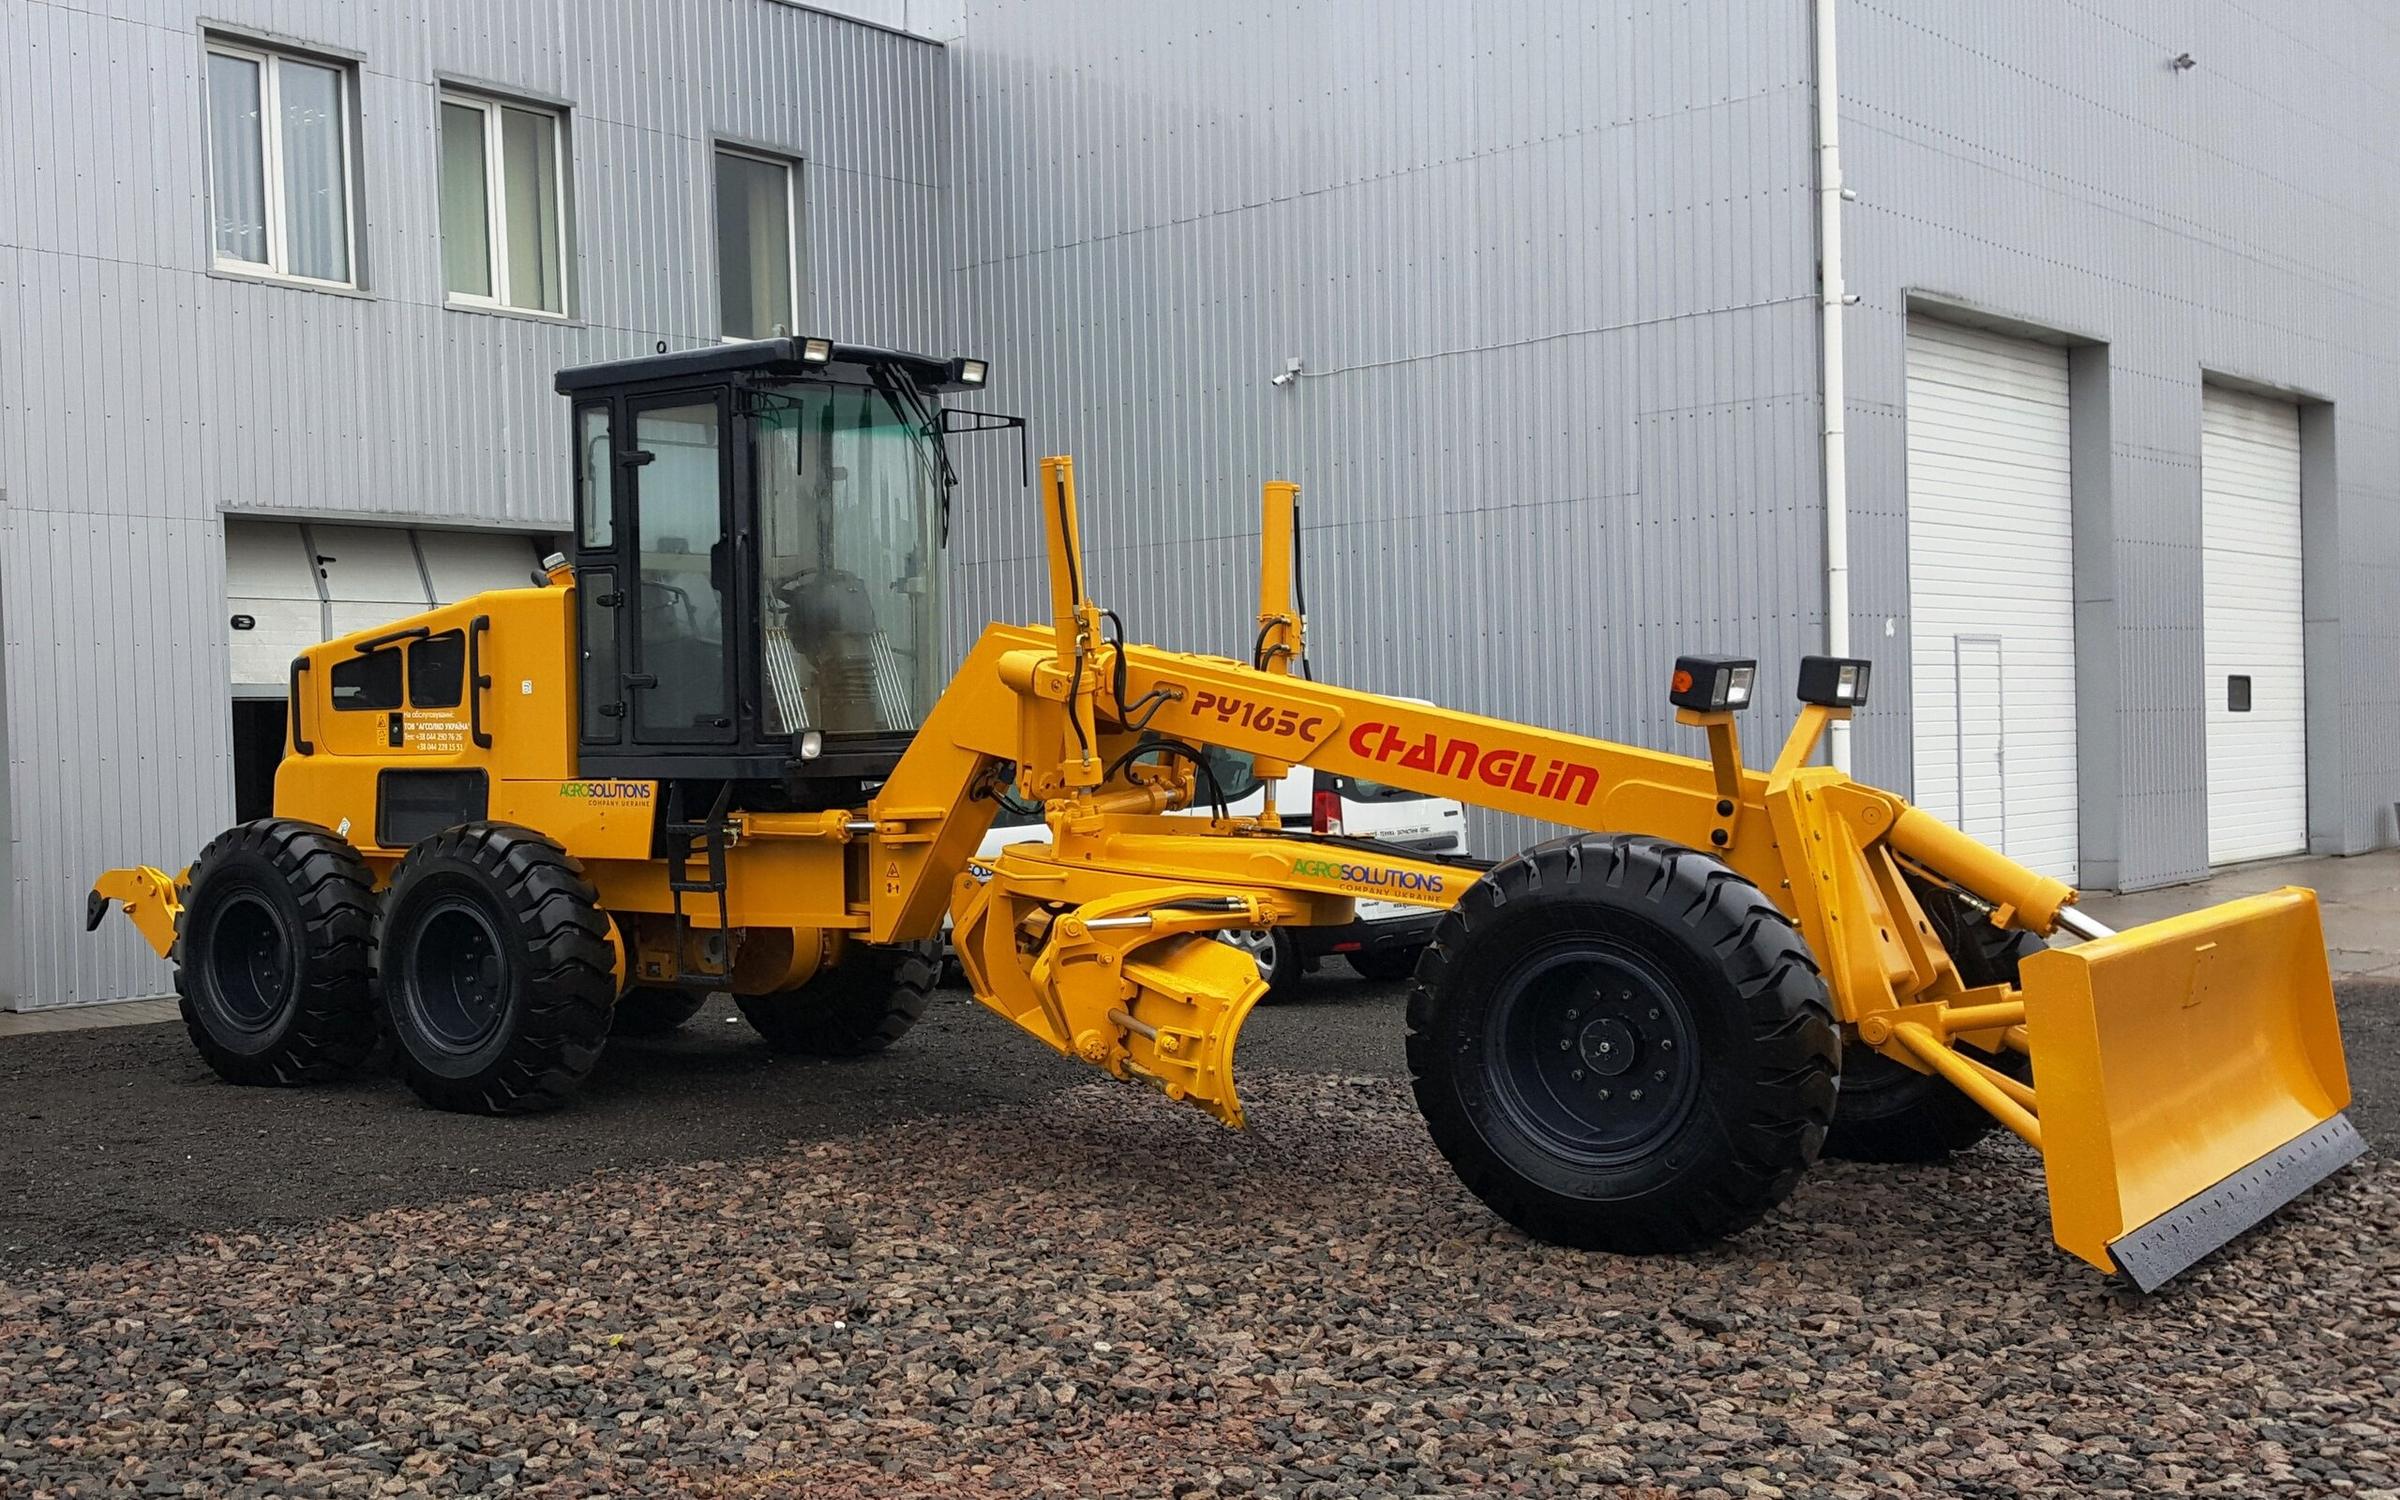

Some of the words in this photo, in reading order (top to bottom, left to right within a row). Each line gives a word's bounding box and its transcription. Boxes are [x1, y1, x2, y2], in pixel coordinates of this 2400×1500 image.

[1190, 691, 1323, 743] PY165C
[1348, 721, 1600, 806] CHANGLIN
[559, 783, 650, 798] AGROSOLUTIONS
[1292, 858, 1444, 893] AGROSOLUTIONS
[1339, 883, 1390, 896] COMPANY
[1394, 890, 1442, 903] UKRAINE
